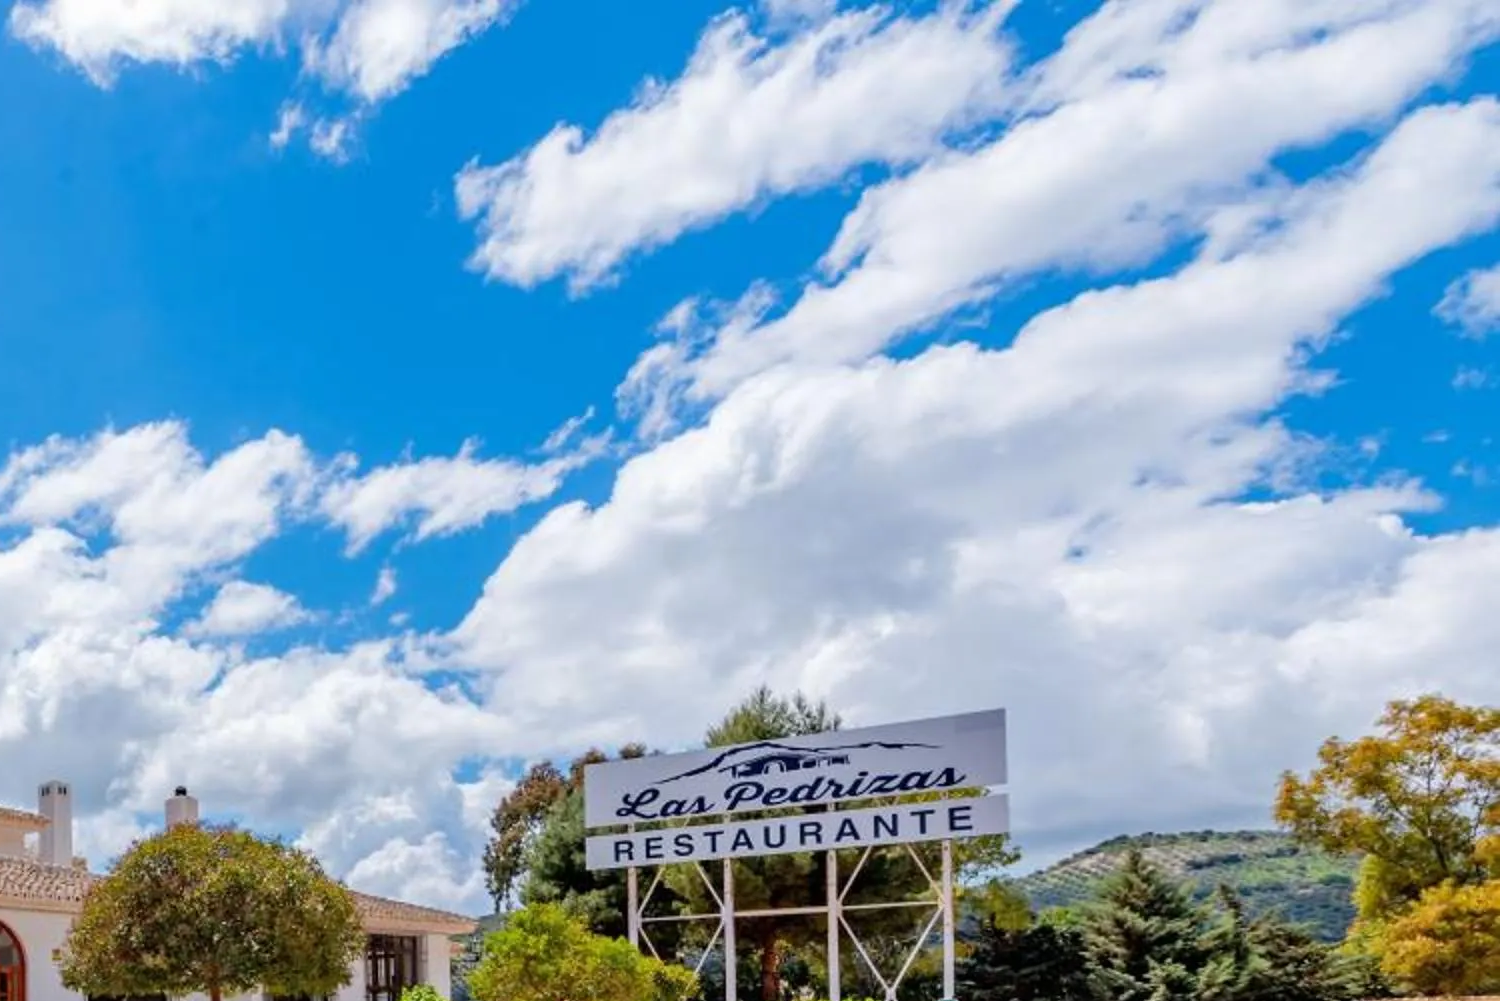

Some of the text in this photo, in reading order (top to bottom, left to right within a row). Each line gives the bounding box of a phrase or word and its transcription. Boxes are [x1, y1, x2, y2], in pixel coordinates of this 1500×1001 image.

[616, 766, 967, 820] Las Pedrizas
[613, 806, 974, 863] RESTAURANTE
